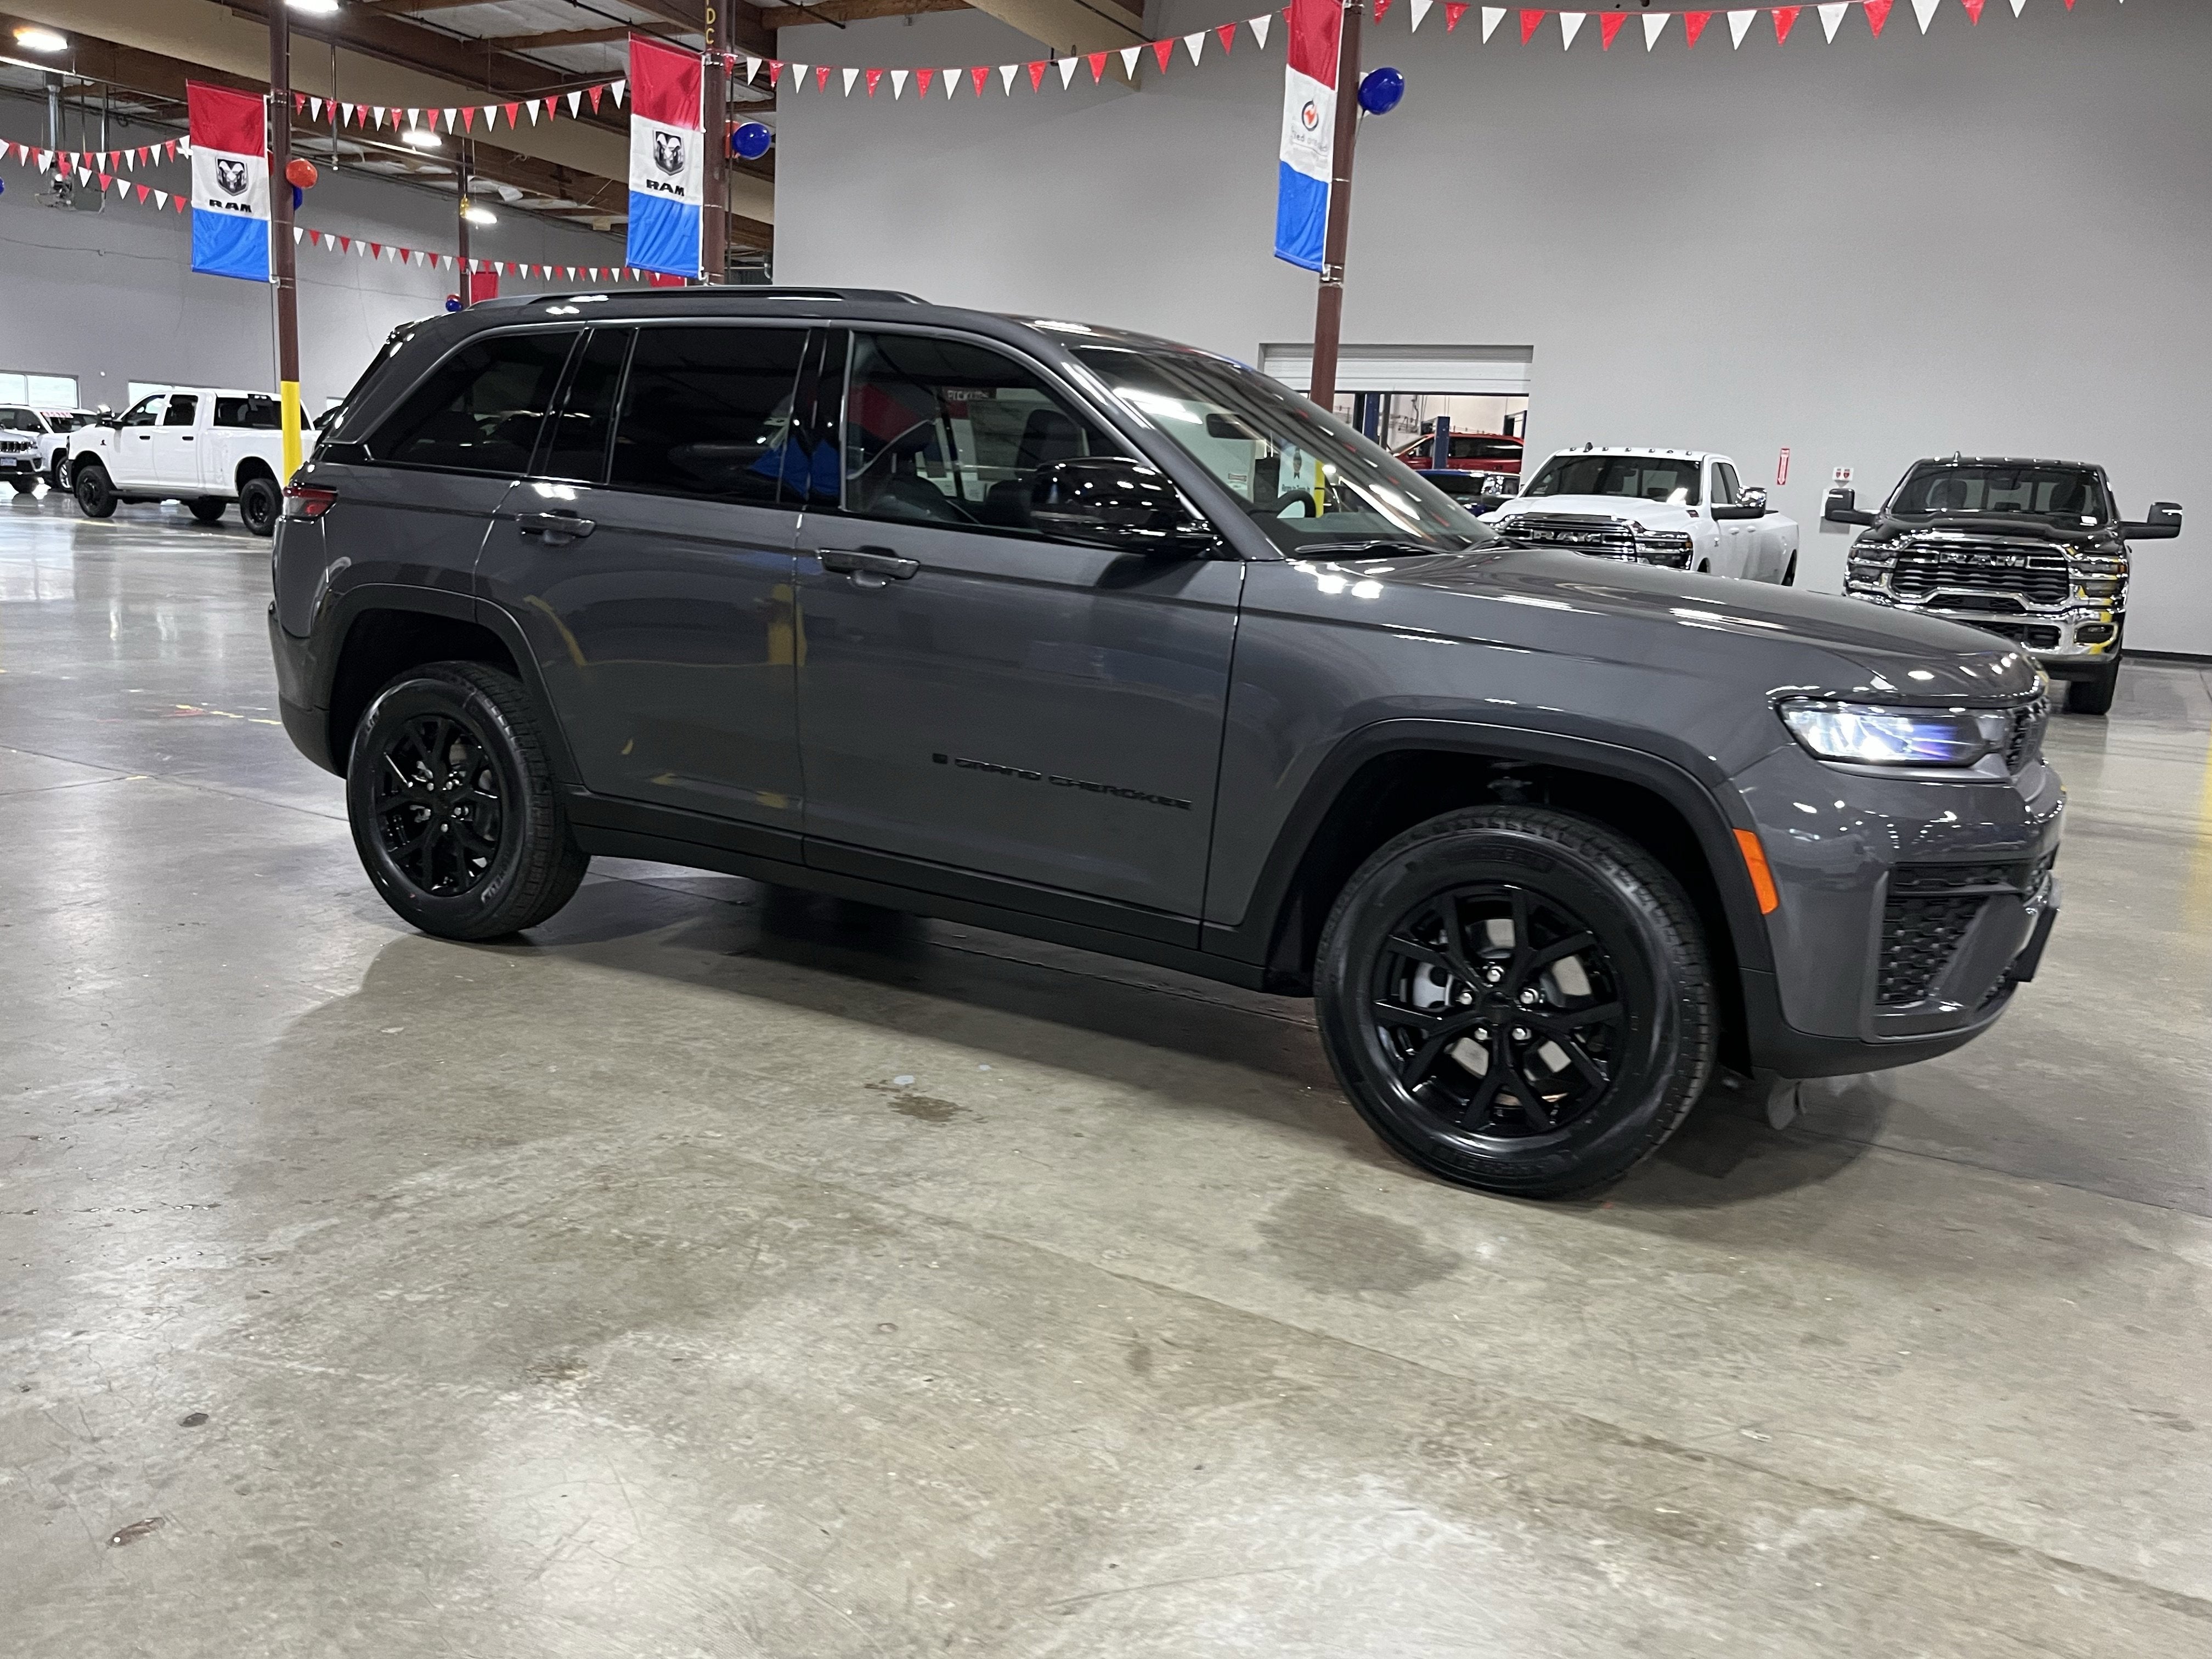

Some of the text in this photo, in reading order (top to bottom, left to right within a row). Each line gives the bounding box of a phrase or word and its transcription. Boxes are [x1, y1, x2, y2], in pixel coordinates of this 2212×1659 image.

[646, 179, 685, 196] RAM
[210, 199, 252, 213] RAM
[1533, 529, 1601, 543] RAM
[1939, 552, 2025, 567] RAM
